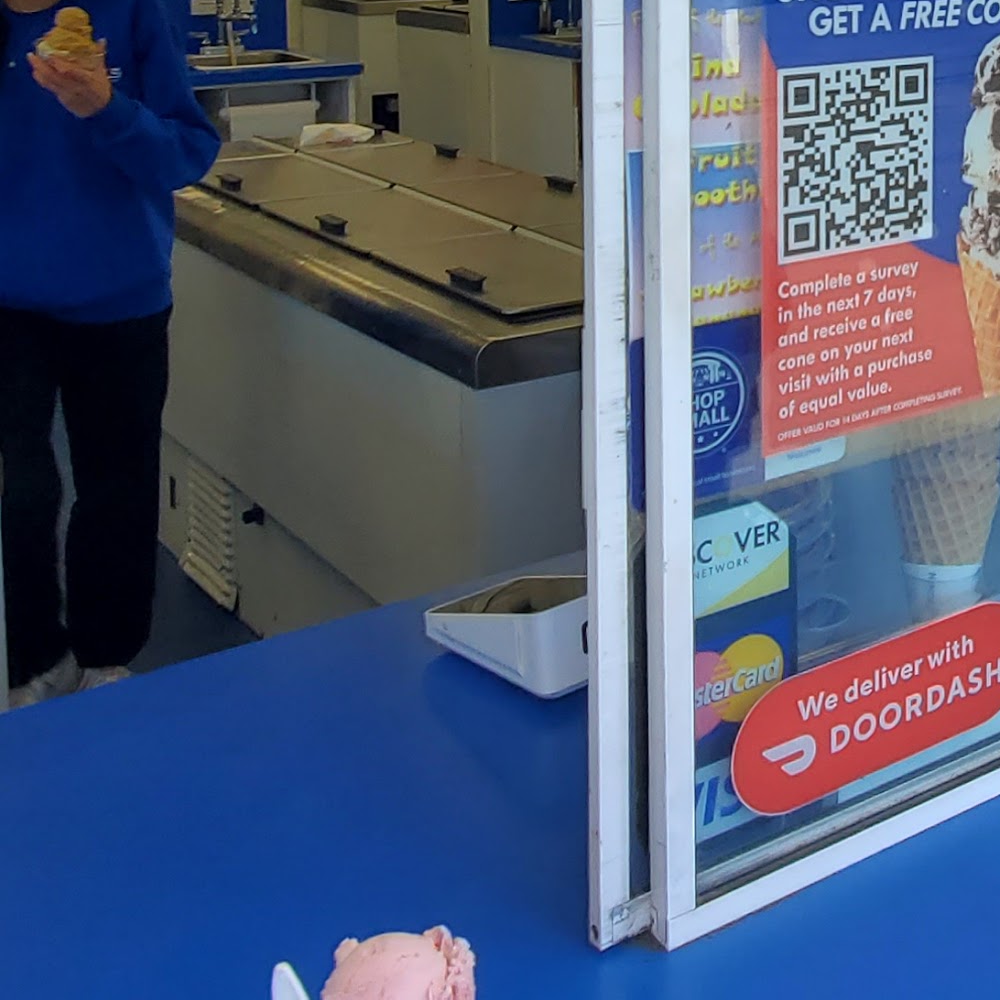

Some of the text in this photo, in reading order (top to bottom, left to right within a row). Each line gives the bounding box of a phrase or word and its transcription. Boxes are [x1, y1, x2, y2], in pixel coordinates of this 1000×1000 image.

[809, 5, 863, 36] GET
[870, 2, 892, 32] A
[900, 0, 962, 29] FREE
[778, 261, 919, 300] Complete a survey
[778, 306, 792, 324] in
[798, 301, 822, 319] the
[826, 295, 860, 313] next
[863, 290, 873, 306] 7
[877, 285, 917, 304] days,
[778, 307, 913, 348] and receive a free
[778, 330, 914, 372] cone on your next
[778, 348, 933, 396] visit with a purchase
[778, 384, 893, 421] of equal value.
[777, 428, 801, 442] OFFER
[803, 422, 824, 437] VALID
[825, 418, 840, 431] FOR
[852, 411, 870, 424] DAYS
[870, 405, 892, 419] AFTER
[798, 634, 975, 721] We deliver with
